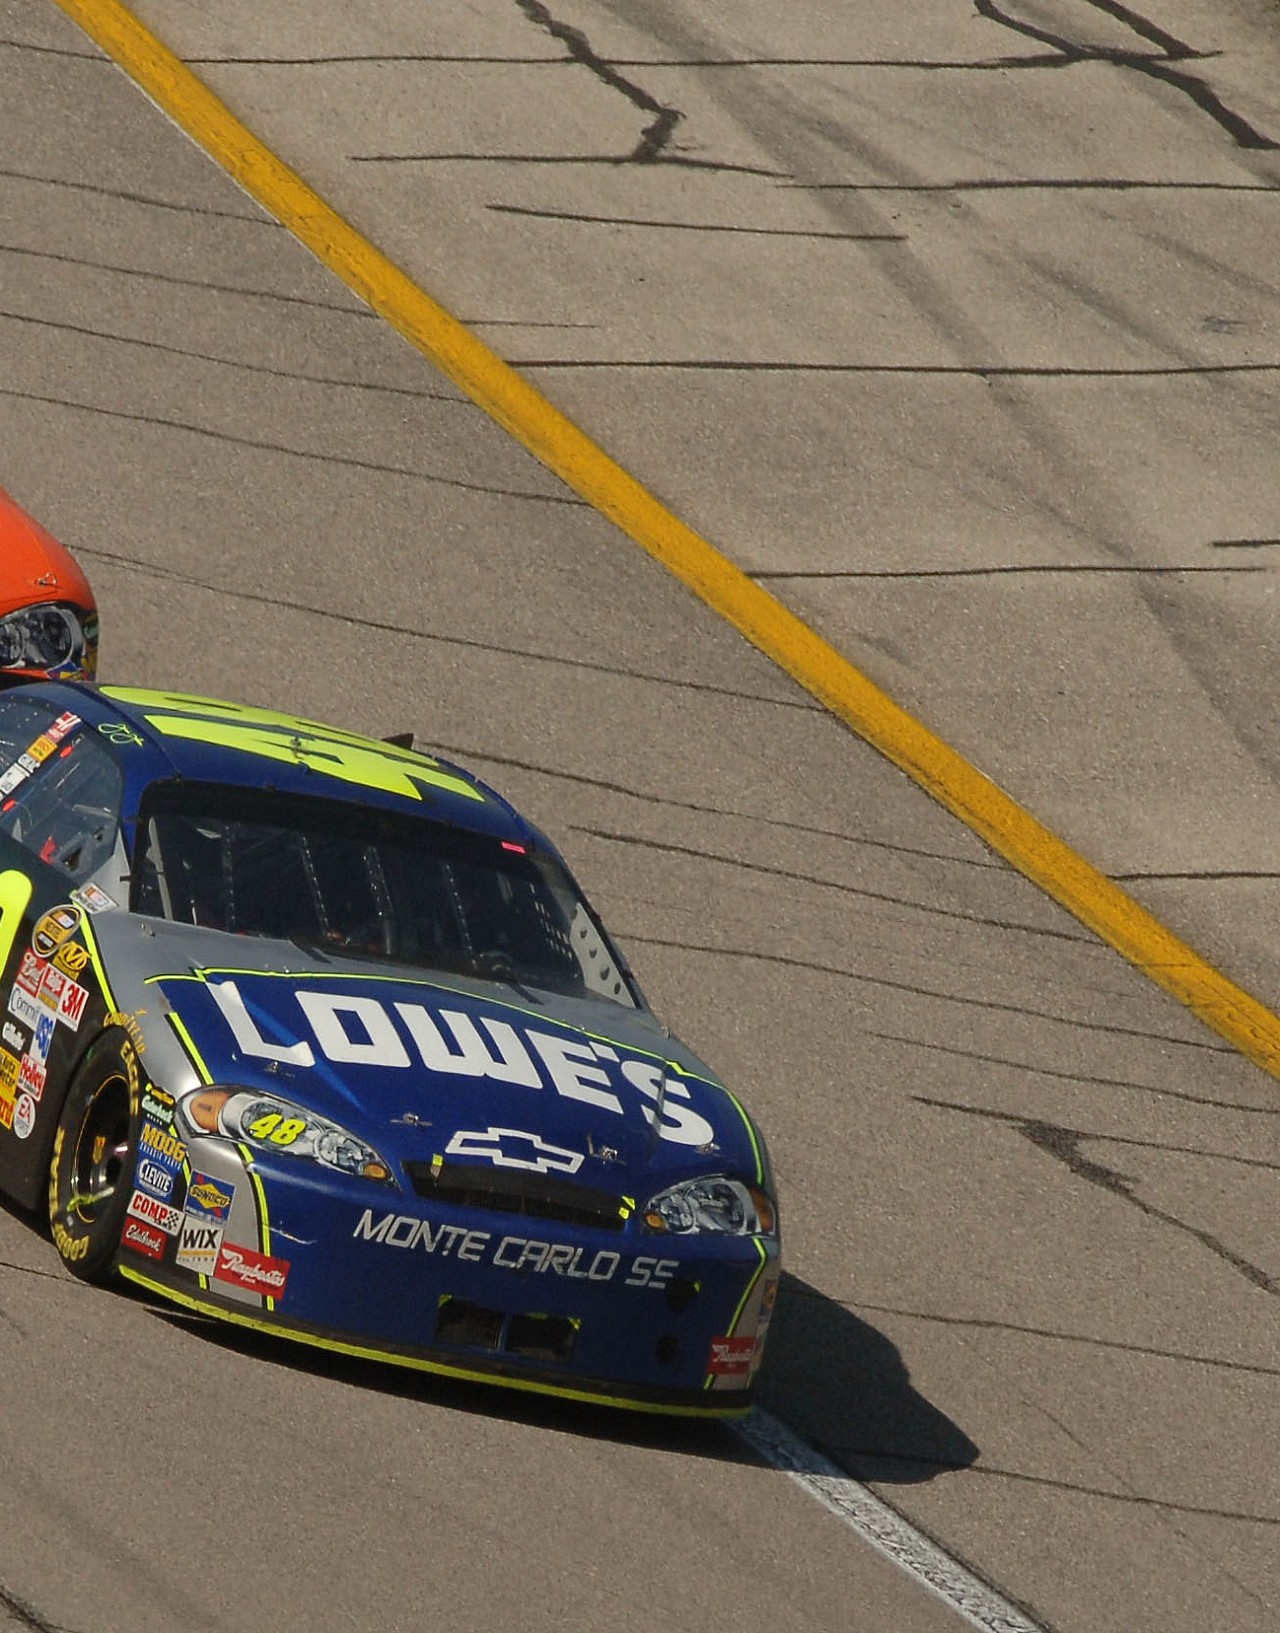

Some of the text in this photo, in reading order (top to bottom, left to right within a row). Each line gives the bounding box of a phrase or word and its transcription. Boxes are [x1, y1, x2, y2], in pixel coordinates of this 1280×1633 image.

[61, 983, 86, 1022] 3M
[204, 980, 717, 1147] LOWE'S
[140, 1123, 188, 1162] MOOG
[249, 1112, 306, 1146] 48
[138, 1158, 171, 1193] CLEVITE
[132, 1193, 169, 1222] COMP
[190, 1185, 231, 1208] SUNOCO
[182, 1229, 219, 1249] WIX
[353, 1209, 681, 1289] MONTE CARLO SS
[221, 1248, 285, 1287] Raybestos
